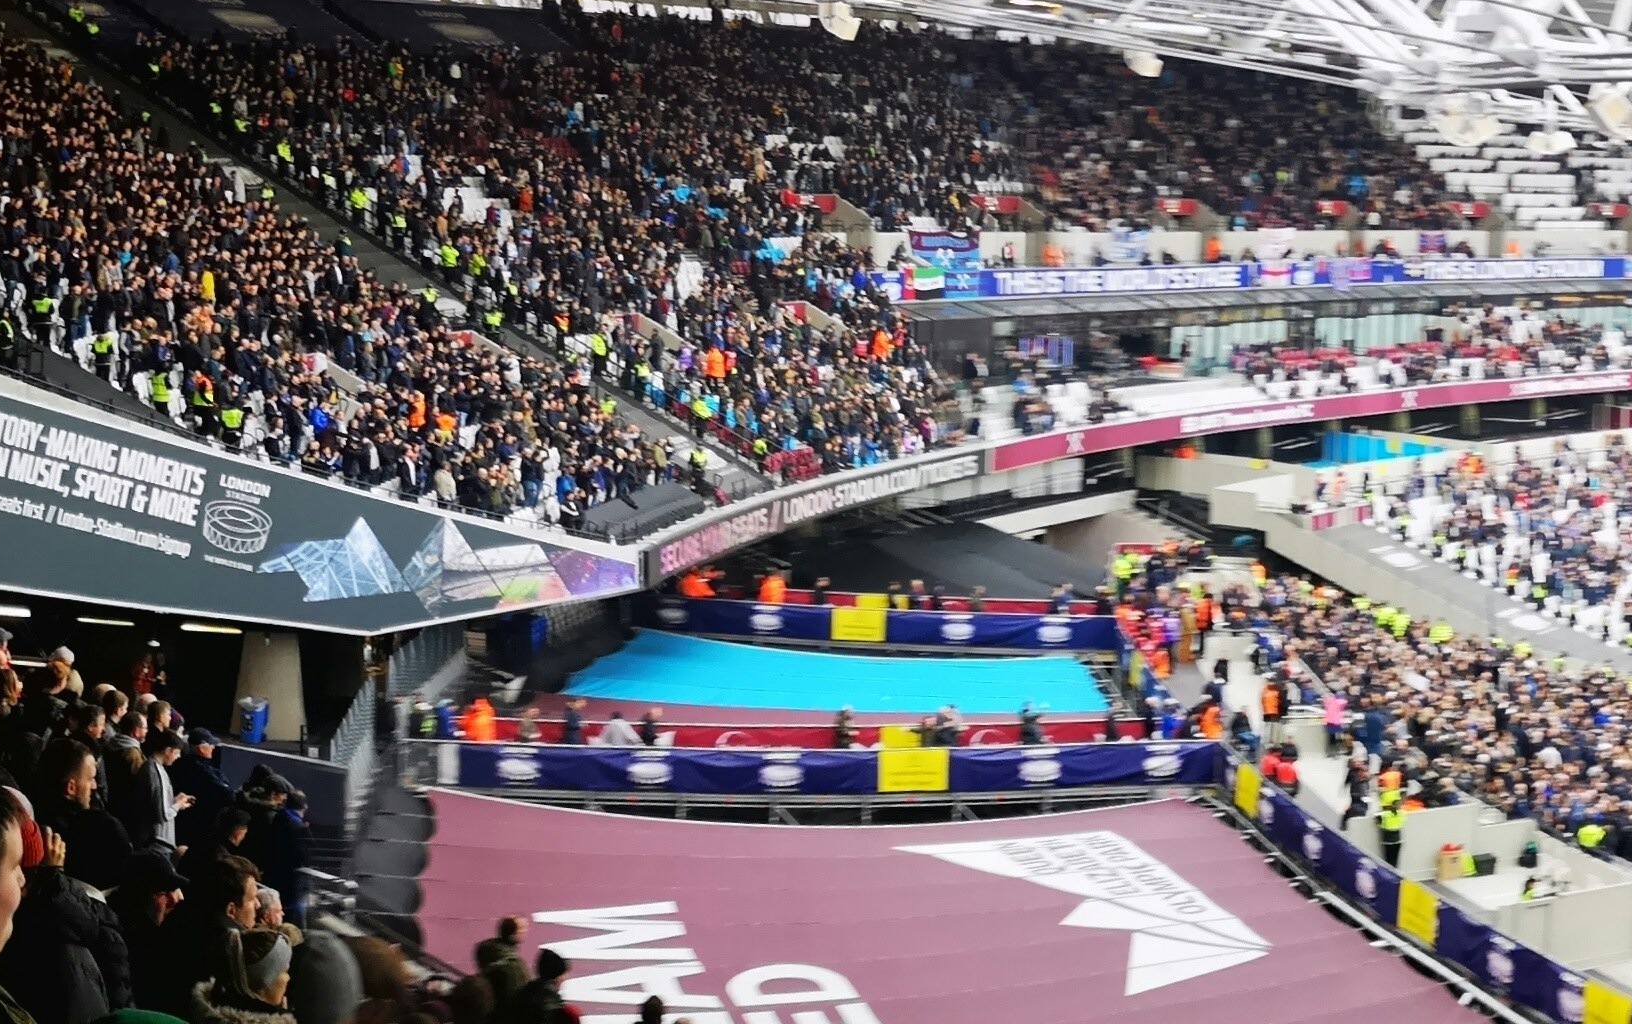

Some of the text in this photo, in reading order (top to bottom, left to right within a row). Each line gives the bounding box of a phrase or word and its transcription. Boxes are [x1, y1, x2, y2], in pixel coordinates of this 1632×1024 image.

[8, 450, 70, 498] MUSIC,
[72, 468, 135, 509] SPORT
[131, 484, 149, 513] &
[148, 487, 201, 527] MORE
[118, 447, 207, 496] MOMENTS
[219, 473, 271, 498] LONDON
[22, 499, 46, 522] first
